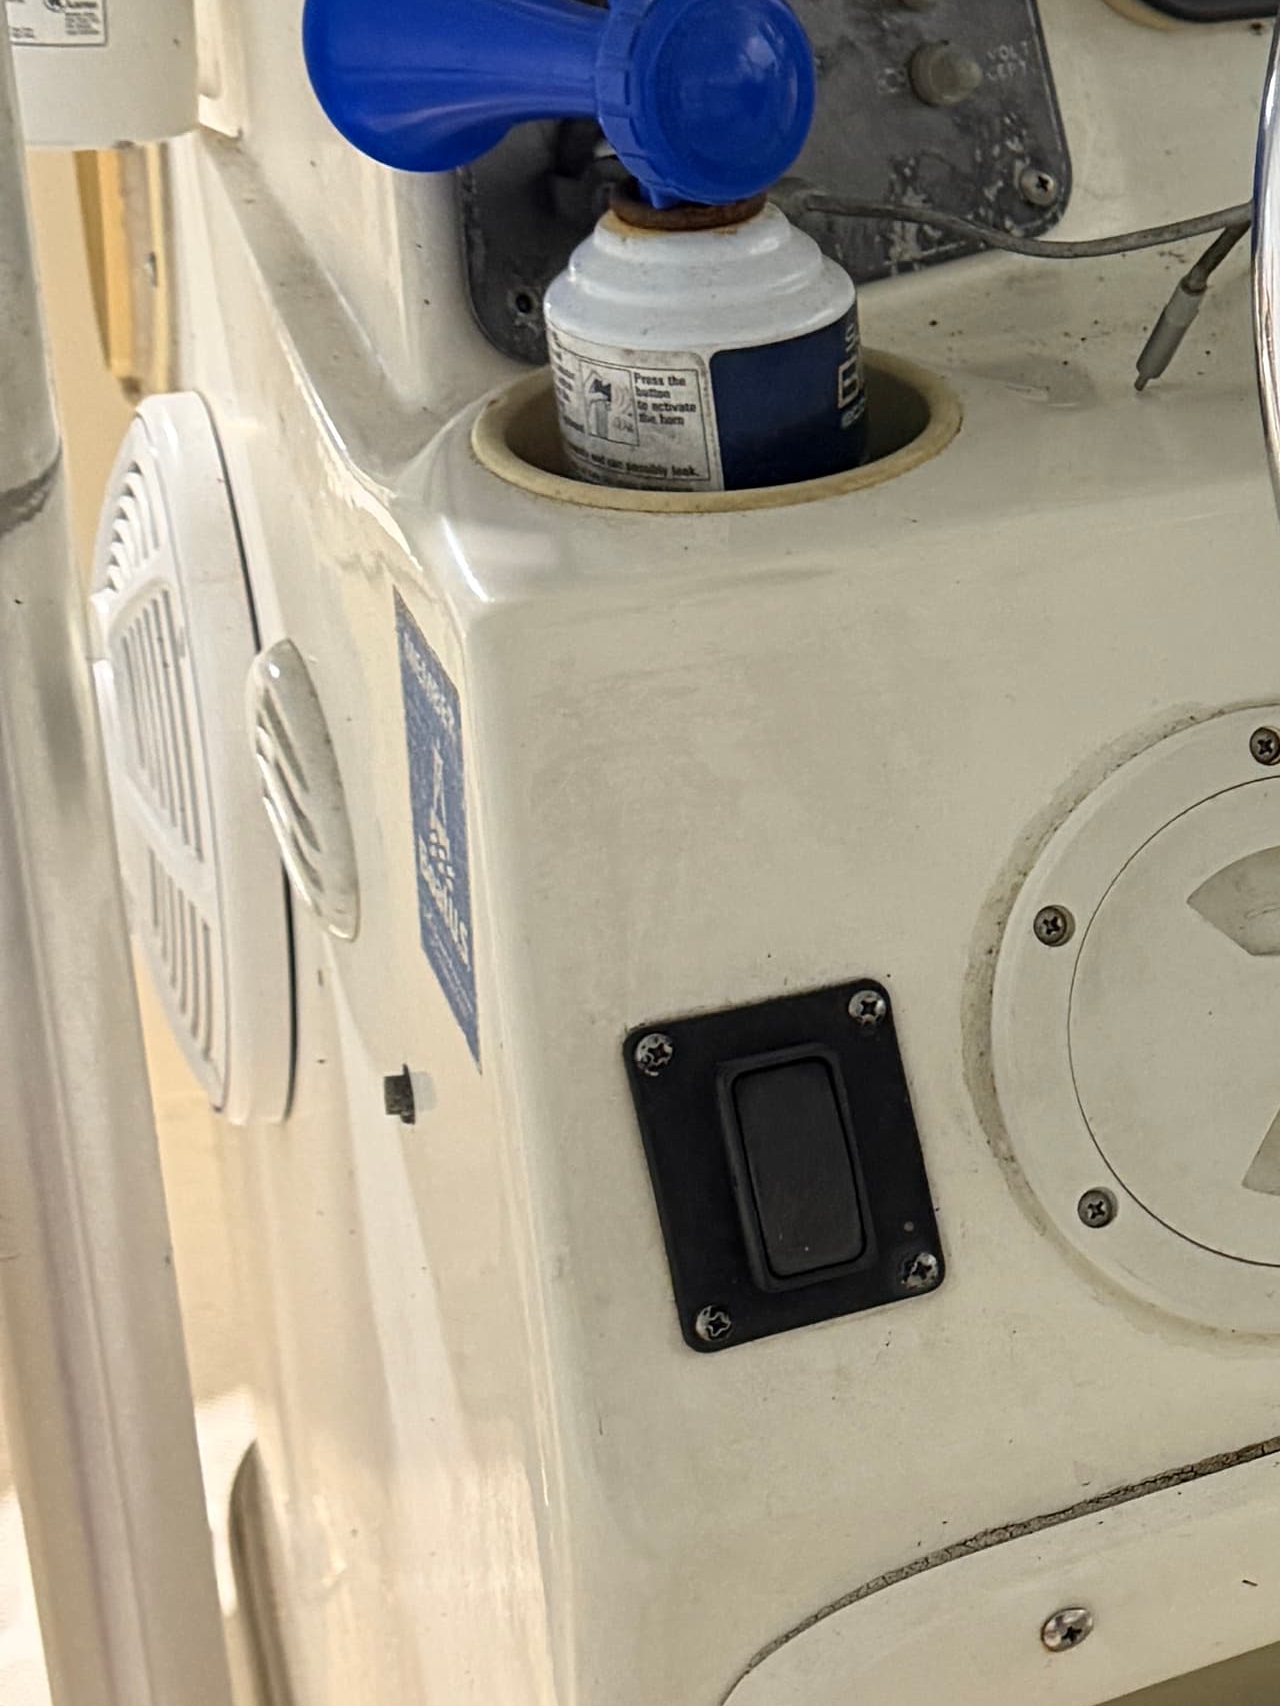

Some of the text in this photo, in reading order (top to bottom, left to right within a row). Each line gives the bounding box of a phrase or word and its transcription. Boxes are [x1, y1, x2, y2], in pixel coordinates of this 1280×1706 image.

[633, 372, 687, 388] Press the
[635, 387, 671, 400] button
[636, 400, 697, 413] to activate
[639, 412, 685, 426] the horn
